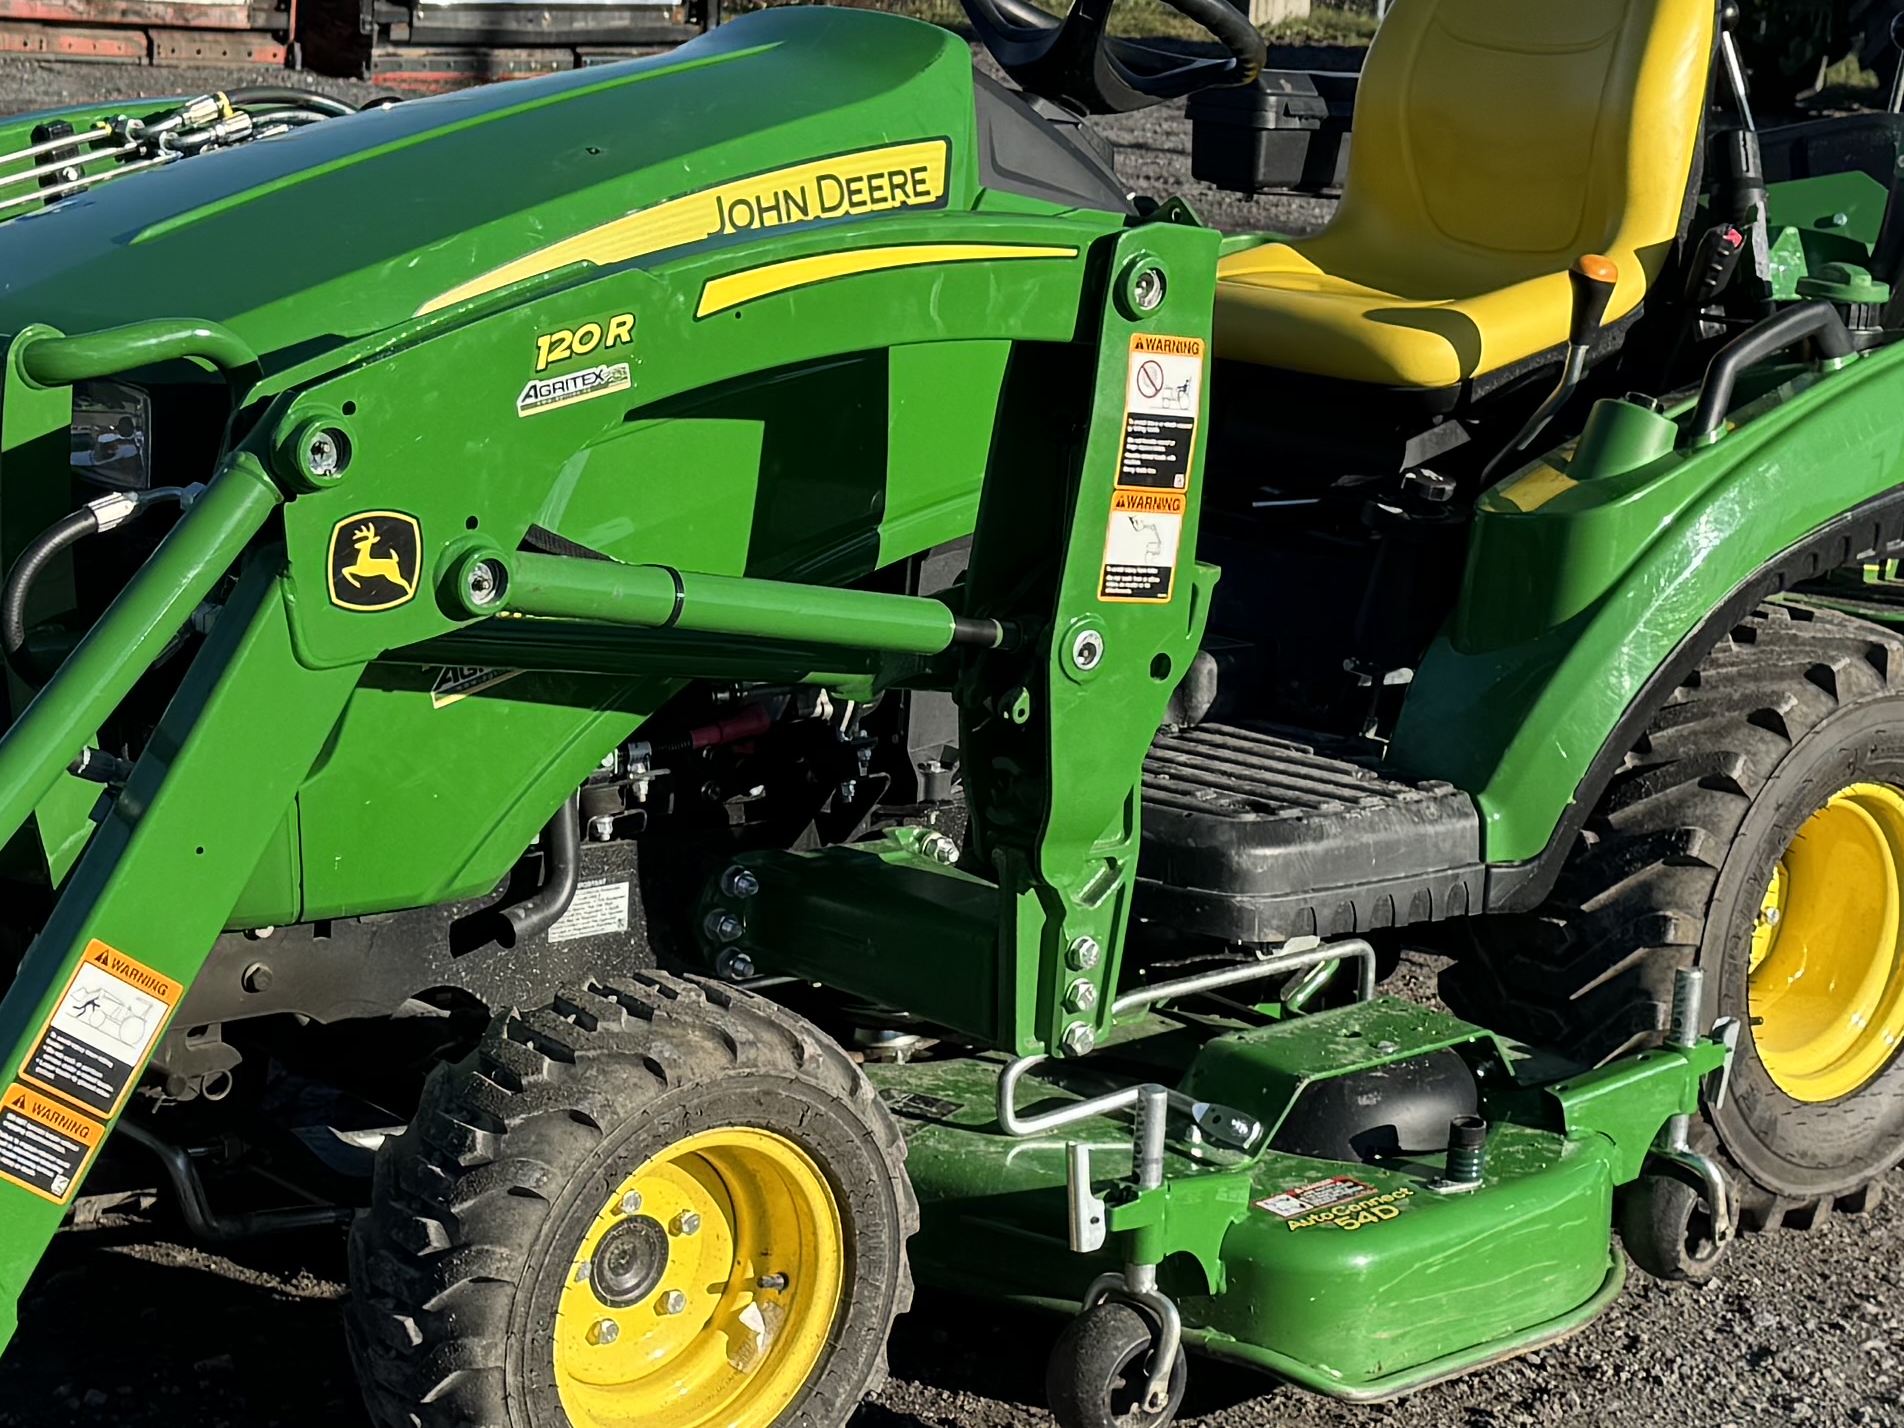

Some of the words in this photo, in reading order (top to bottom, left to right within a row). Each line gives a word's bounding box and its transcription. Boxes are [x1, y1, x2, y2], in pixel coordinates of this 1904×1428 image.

[707, 185, 809, 234] JOHN
[816, 165, 931, 215] DEERE
[1145, 337, 1200, 355] WARNING
[520, 369, 605, 404] AGRITEX
[1126, 495, 1181, 512] WARNING
[111, 957, 169, 996] WARNING
[31, 1102, 90, 1139] WARNING
[1286, 1186, 1415, 1232] AutoConnect
